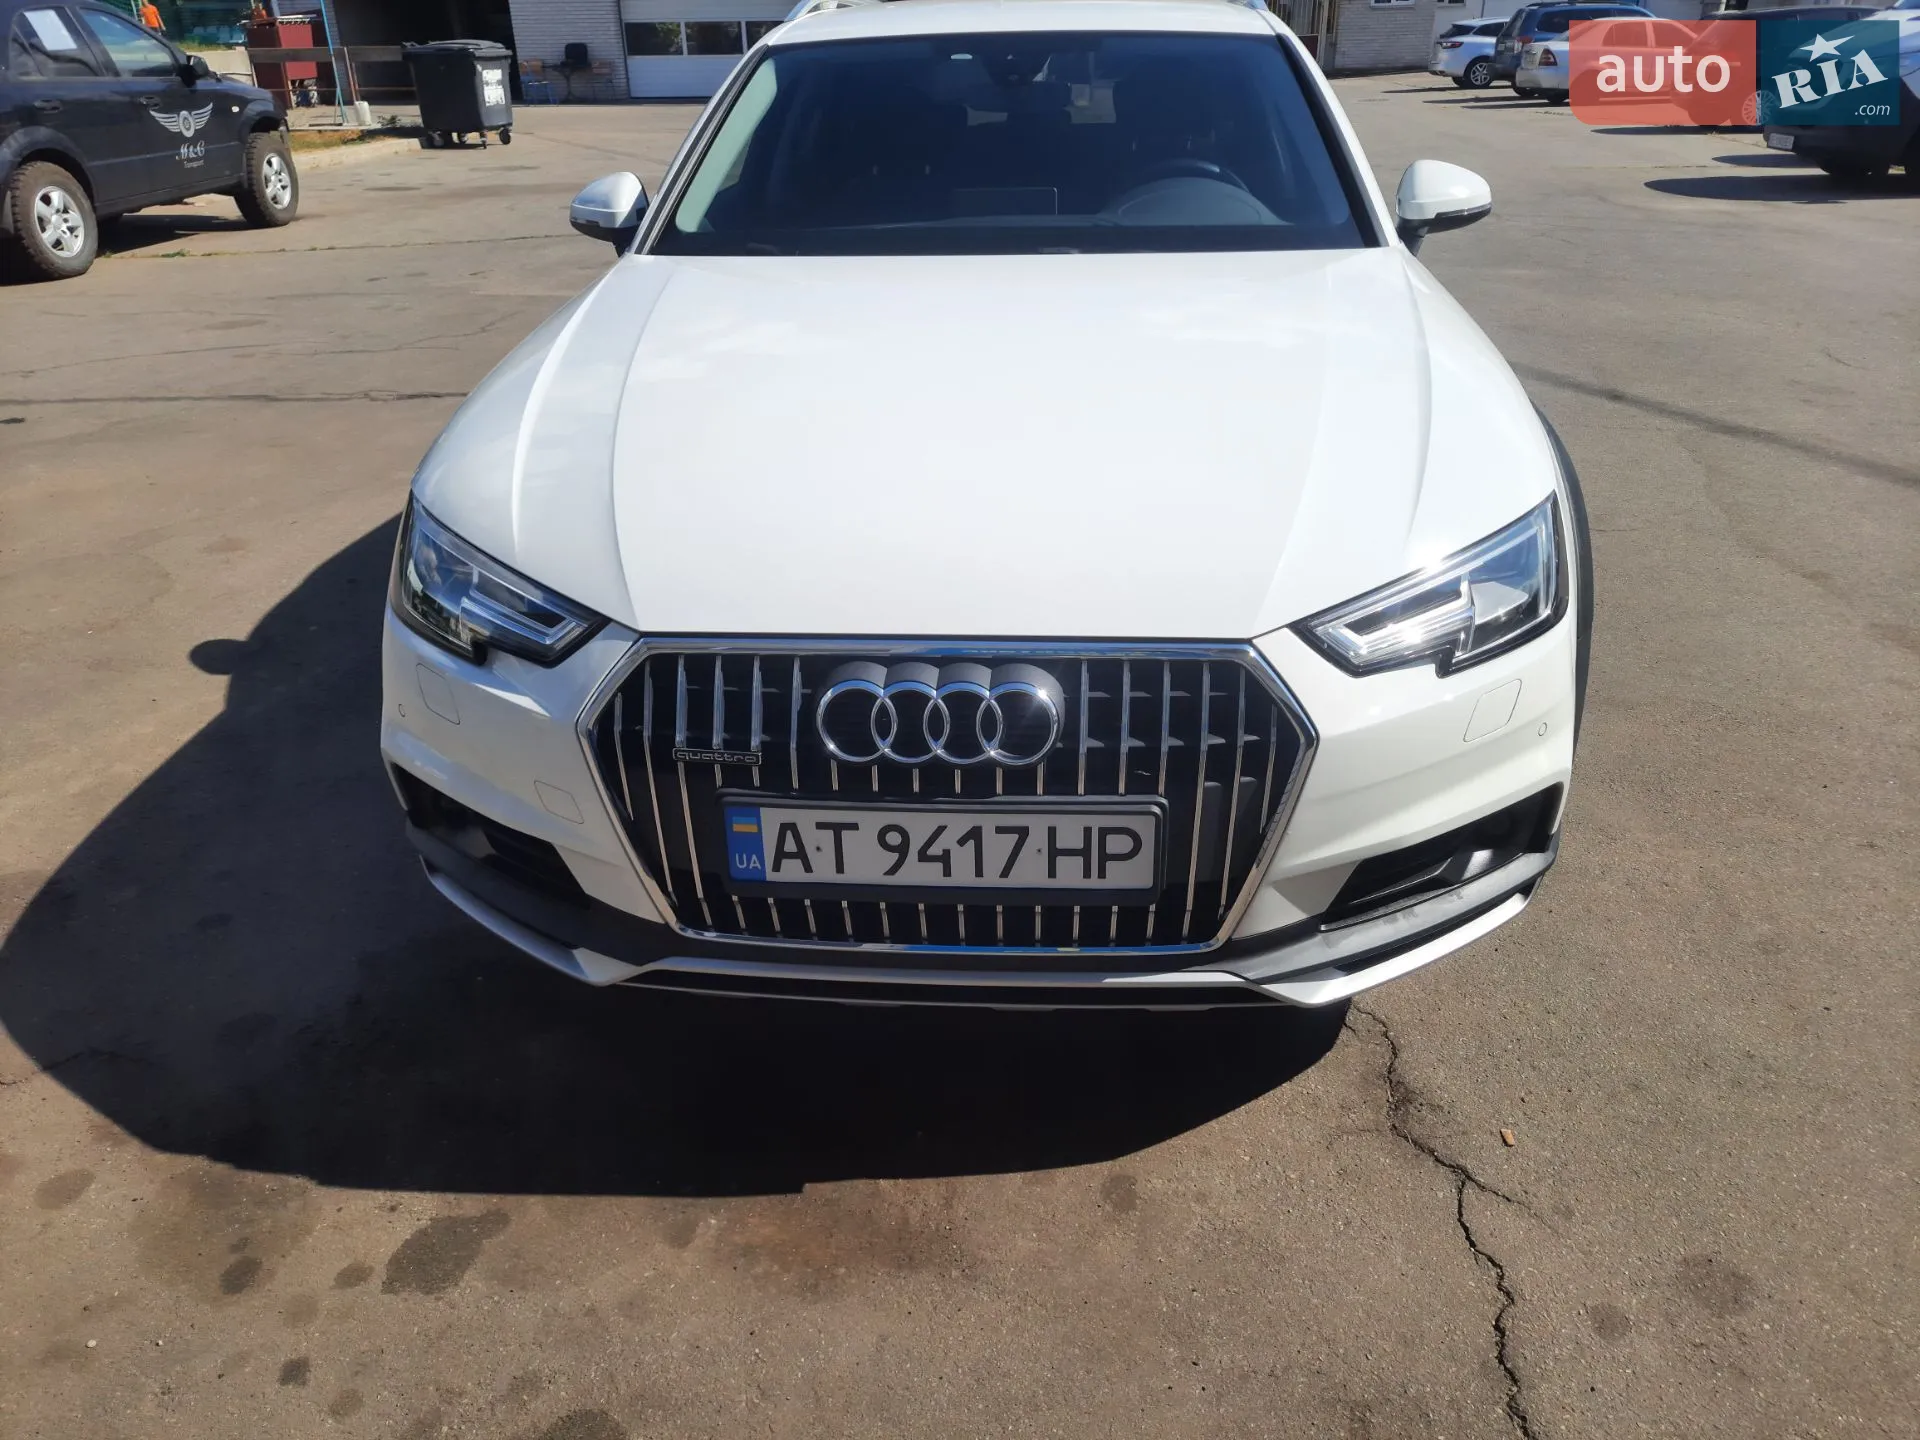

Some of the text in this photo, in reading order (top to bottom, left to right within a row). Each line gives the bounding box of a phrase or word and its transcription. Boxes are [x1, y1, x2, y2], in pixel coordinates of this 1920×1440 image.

[676, 752, 757, 763] quattro
[771, 822, 1143, 880] AT 9417 HP
[735, 853, 761, 870] UA
